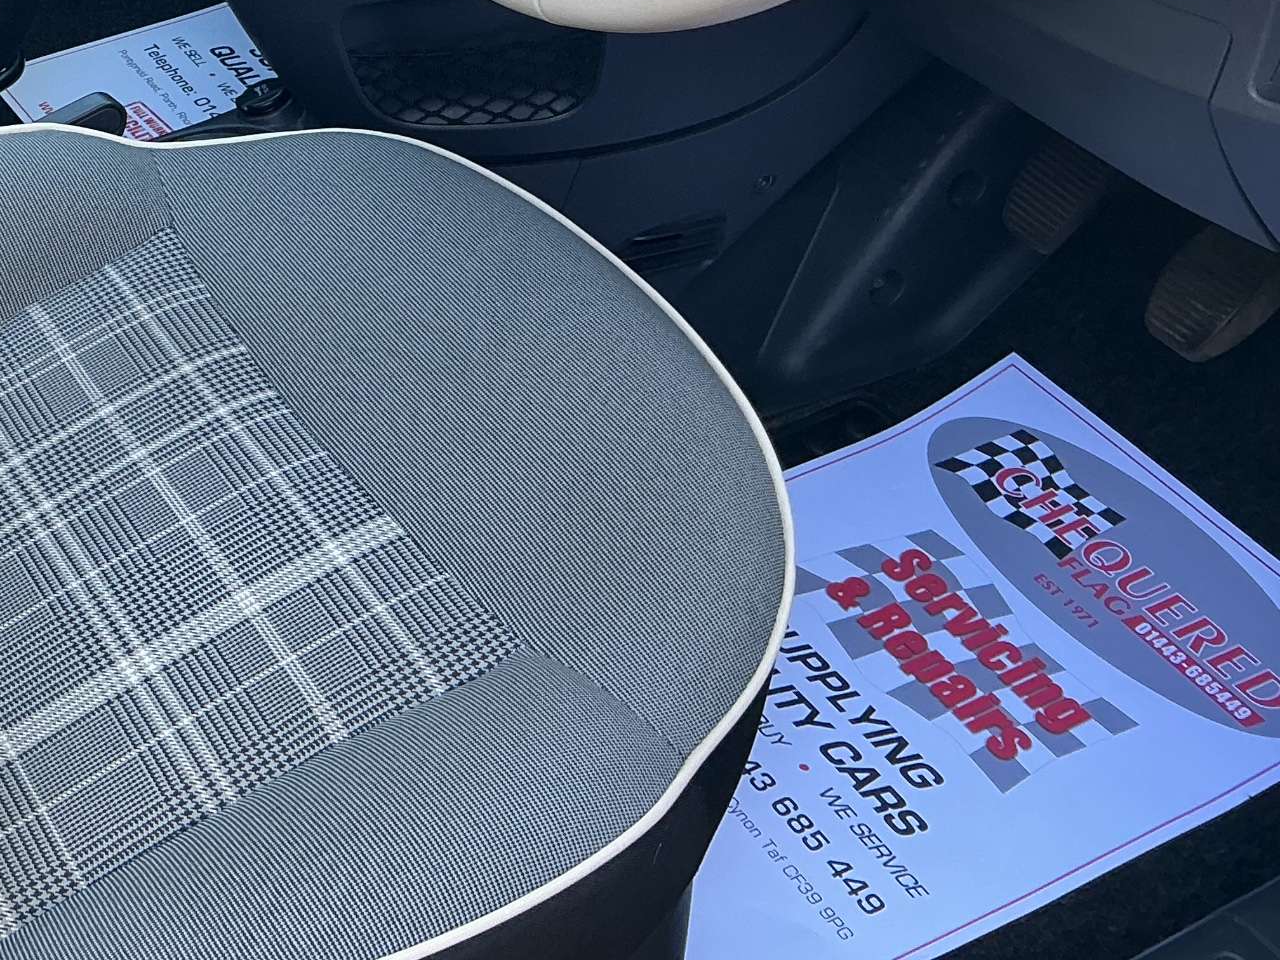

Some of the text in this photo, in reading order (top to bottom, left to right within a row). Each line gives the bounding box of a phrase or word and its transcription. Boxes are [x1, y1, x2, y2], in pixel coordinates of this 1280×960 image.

[209, 45, 261, 87] QUAL
[880, 548, 1093, 735] Servicing
[994, 466, 1280, 710] CHEQUERED
[1033, 572, 1101, 629] EST 1971
[1056, 555, 1133, 618] FLAG
[779, 624, 945, 789] UPPLYING
[825, 576, 1033, 762] & Repairs
[1134, 621, 1253, 722] 01443-685449
[769, 669, 929, 836] ITY CARS
[727, 796, 854, 941] Cynon Taf CF39 9PG
[741, 759, 886, 915] 43 685 449
[819, 786, 858, 821] WE
[849, 822, 931, 899] SERVICE
